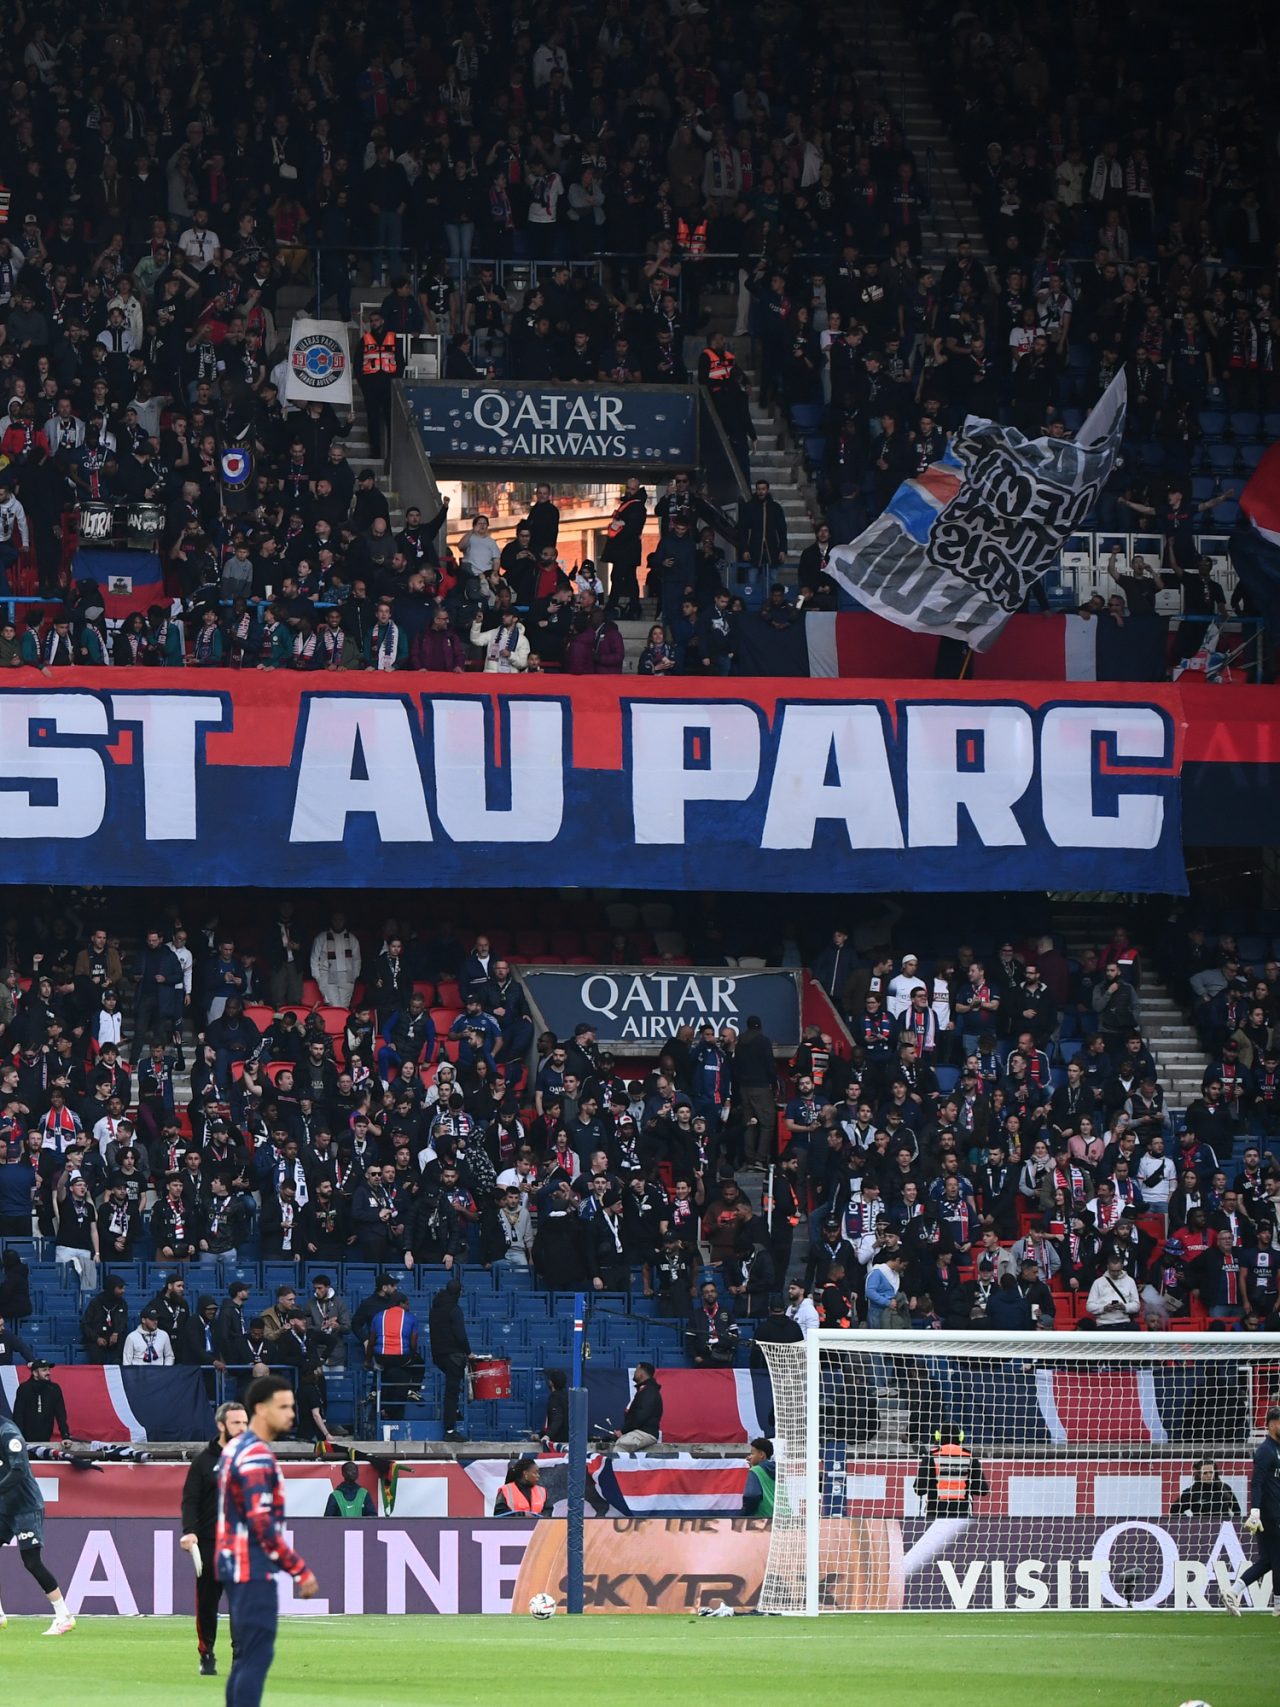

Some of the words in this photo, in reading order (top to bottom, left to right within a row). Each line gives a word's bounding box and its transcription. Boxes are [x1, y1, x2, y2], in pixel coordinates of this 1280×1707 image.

[473, 392, 626, 437] QATAR
[512, 434, 627, 457] AIRWAYS
[289, 696, 565, 843] AU
[630, 702, 1165, 850] PARC
[581, 974, 740, 1021] QATAR
[65, 1529, 536, 1615] AILINE
[936, 1559, 1112, 1609] VISIT
